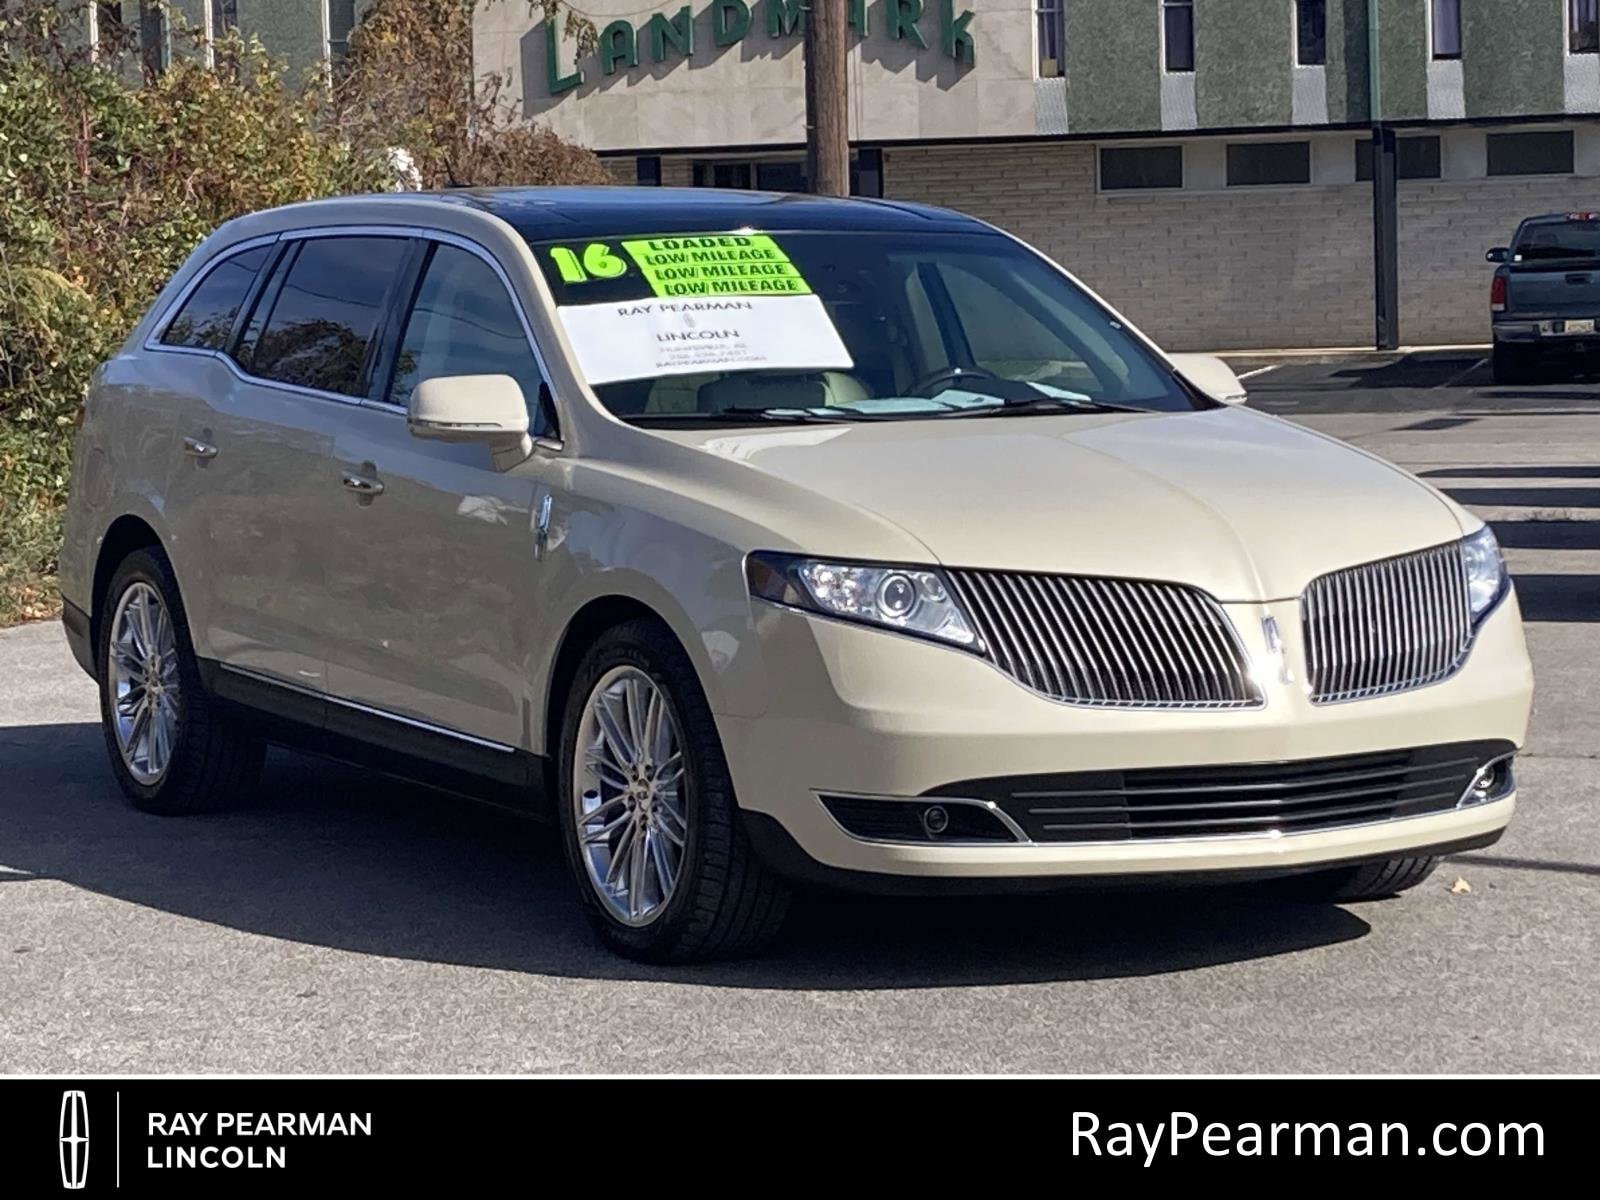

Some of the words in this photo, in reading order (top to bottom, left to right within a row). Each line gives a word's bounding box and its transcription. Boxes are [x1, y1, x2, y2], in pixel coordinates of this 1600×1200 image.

[648, 236, 751, 251] LOADED
[551, 243, 627, 285] 16
[617, 304, 651, 316] RAY
[660, 301, 752, 312] PEARMAN
[656, 329, 740, 342] LINCOLN
